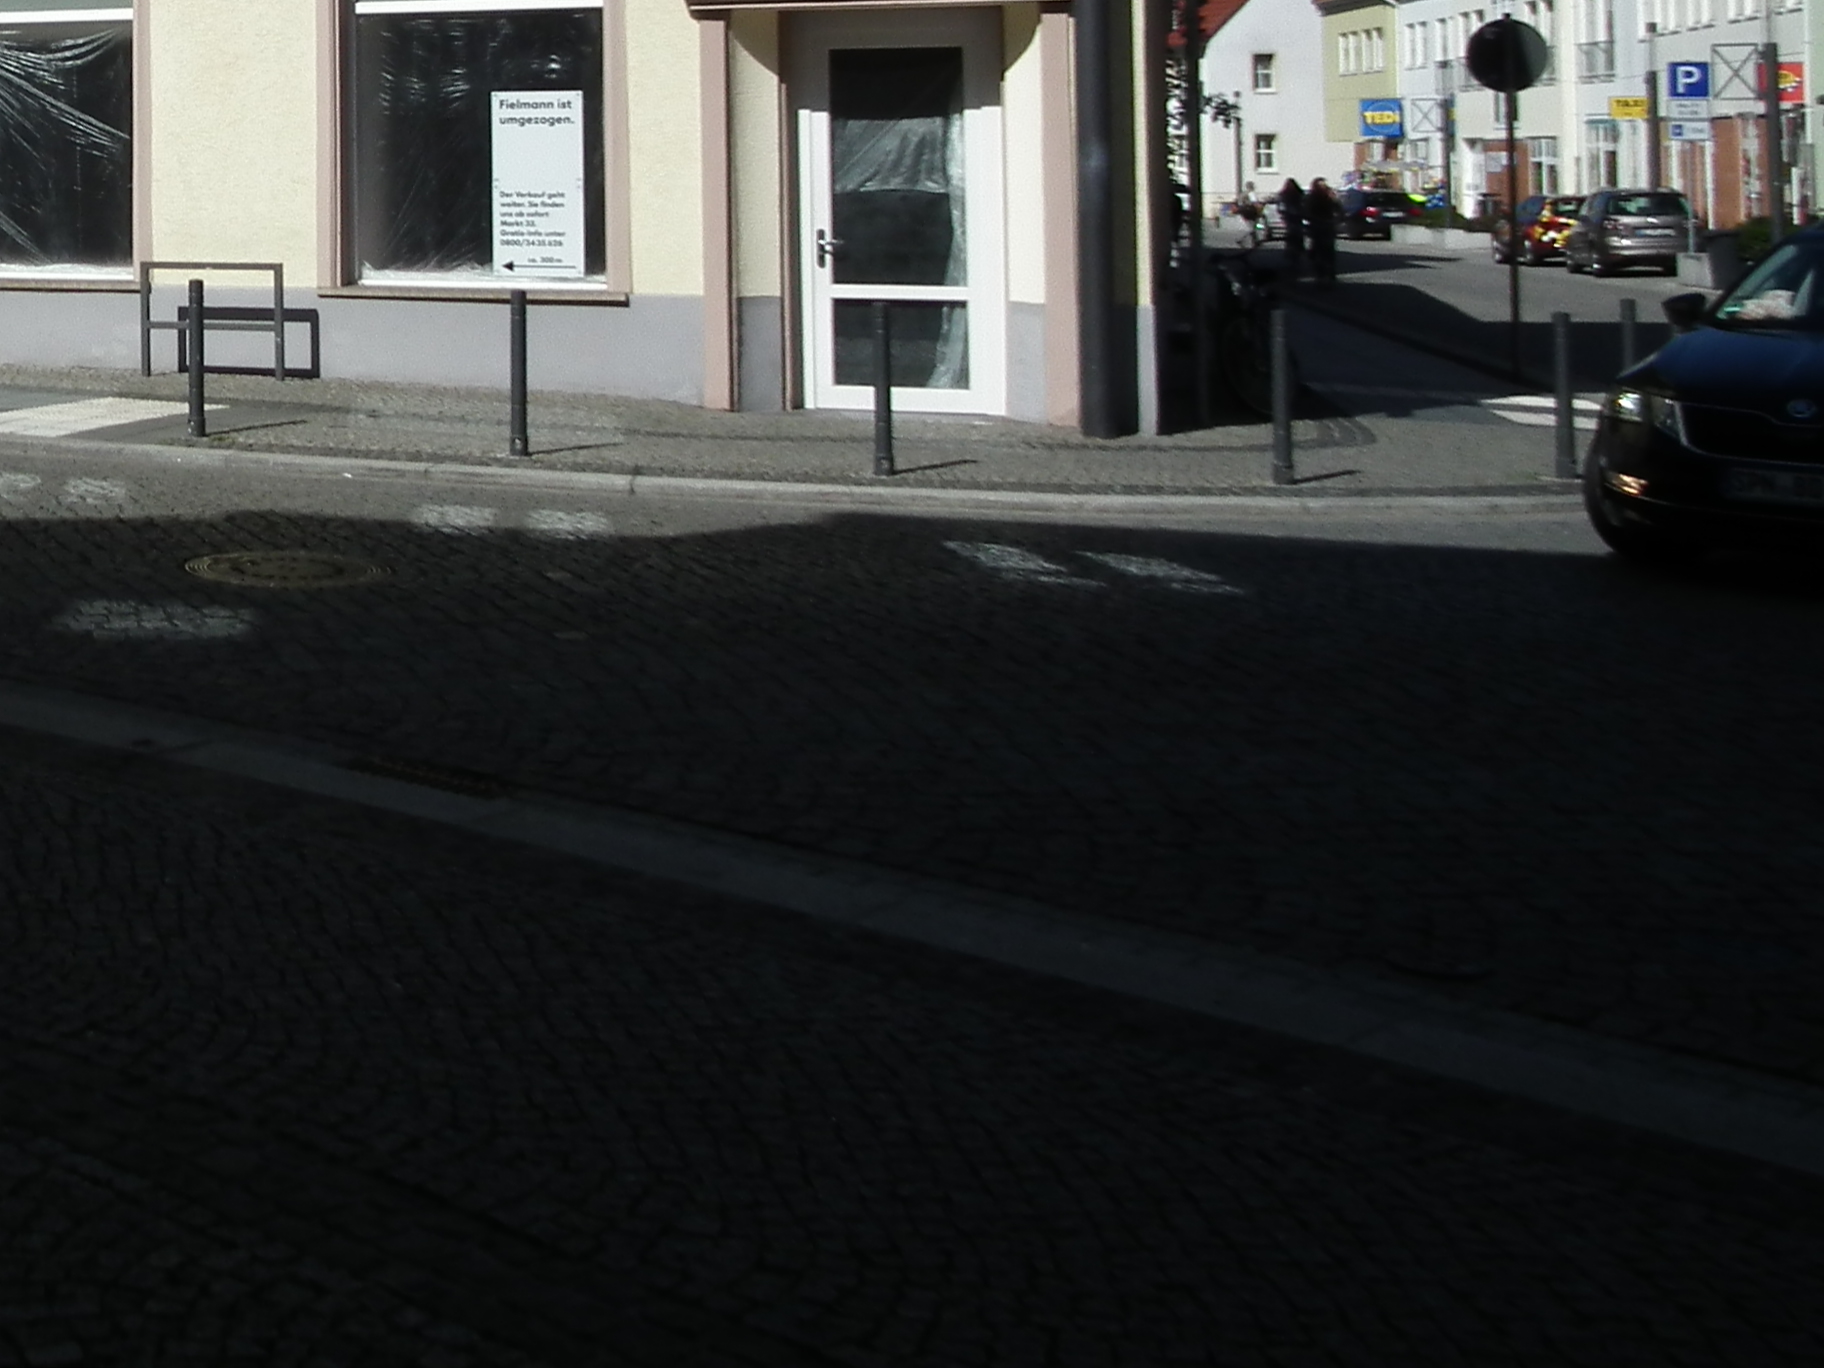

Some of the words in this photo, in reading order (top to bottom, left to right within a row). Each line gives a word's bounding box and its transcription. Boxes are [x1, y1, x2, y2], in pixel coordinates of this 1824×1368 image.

[1675, 66, 1702, 94] P
[499, 99, 555, 110] Fielmann
[557, 99, 573, 110] ist
[499, 116, 575, 127] umgezogen.
[547, 191, 566, 199] geht
